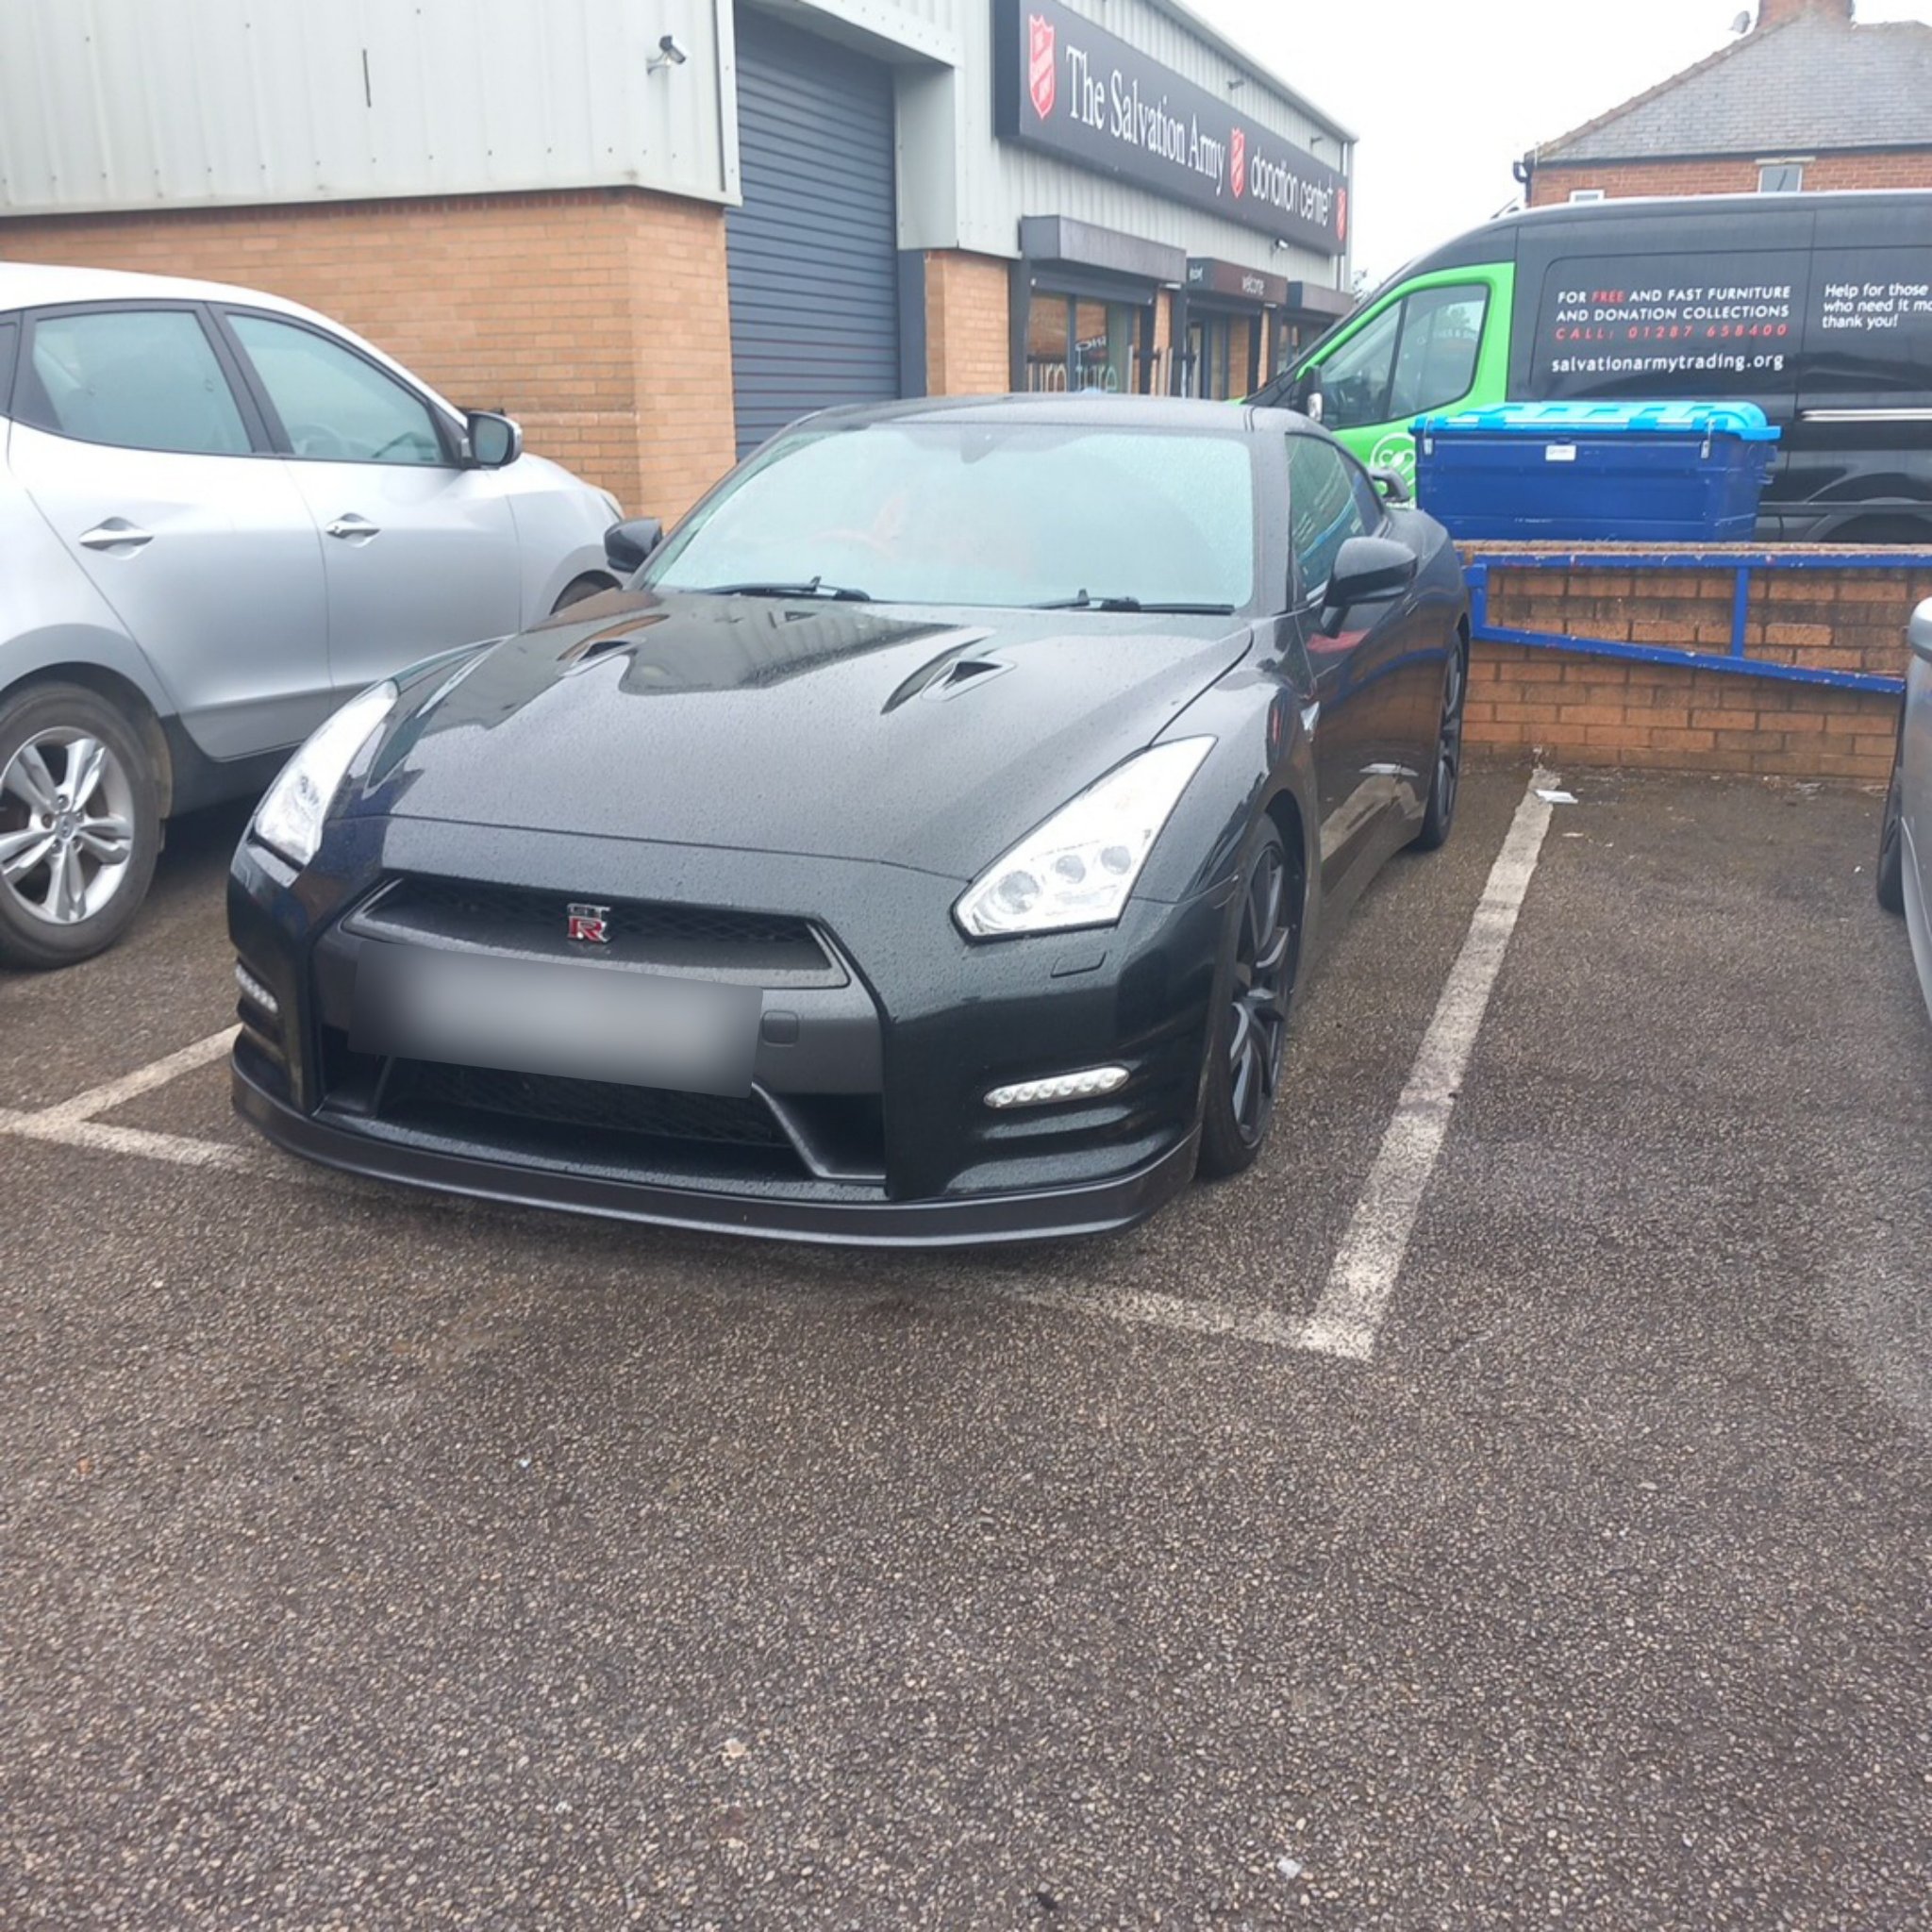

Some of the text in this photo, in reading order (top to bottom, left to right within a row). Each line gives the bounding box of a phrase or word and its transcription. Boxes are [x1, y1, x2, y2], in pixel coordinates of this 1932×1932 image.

[1066, 44, 1225, 196] The Salvation Army
[1251, 146, 1298, 213] donation
[1557, 286, 1791, 304] FOR FREE AND FAST FURNITURE
[1824, 282, 1929, 299] Help for those
[1556, 304, 1790, 322] AND DONATION COLLECTIONS
[1823, 299, 1854, 312] who
[1857, 298, 1894, 312] need
[1898, 298, 1909, 311] it
[1822, 313, 1899, 331] thank you!
[1556, 323, 1789, 340] CALL: 01287 658400
[1551, 352, 1785, 373] salvationarmytrading.org
